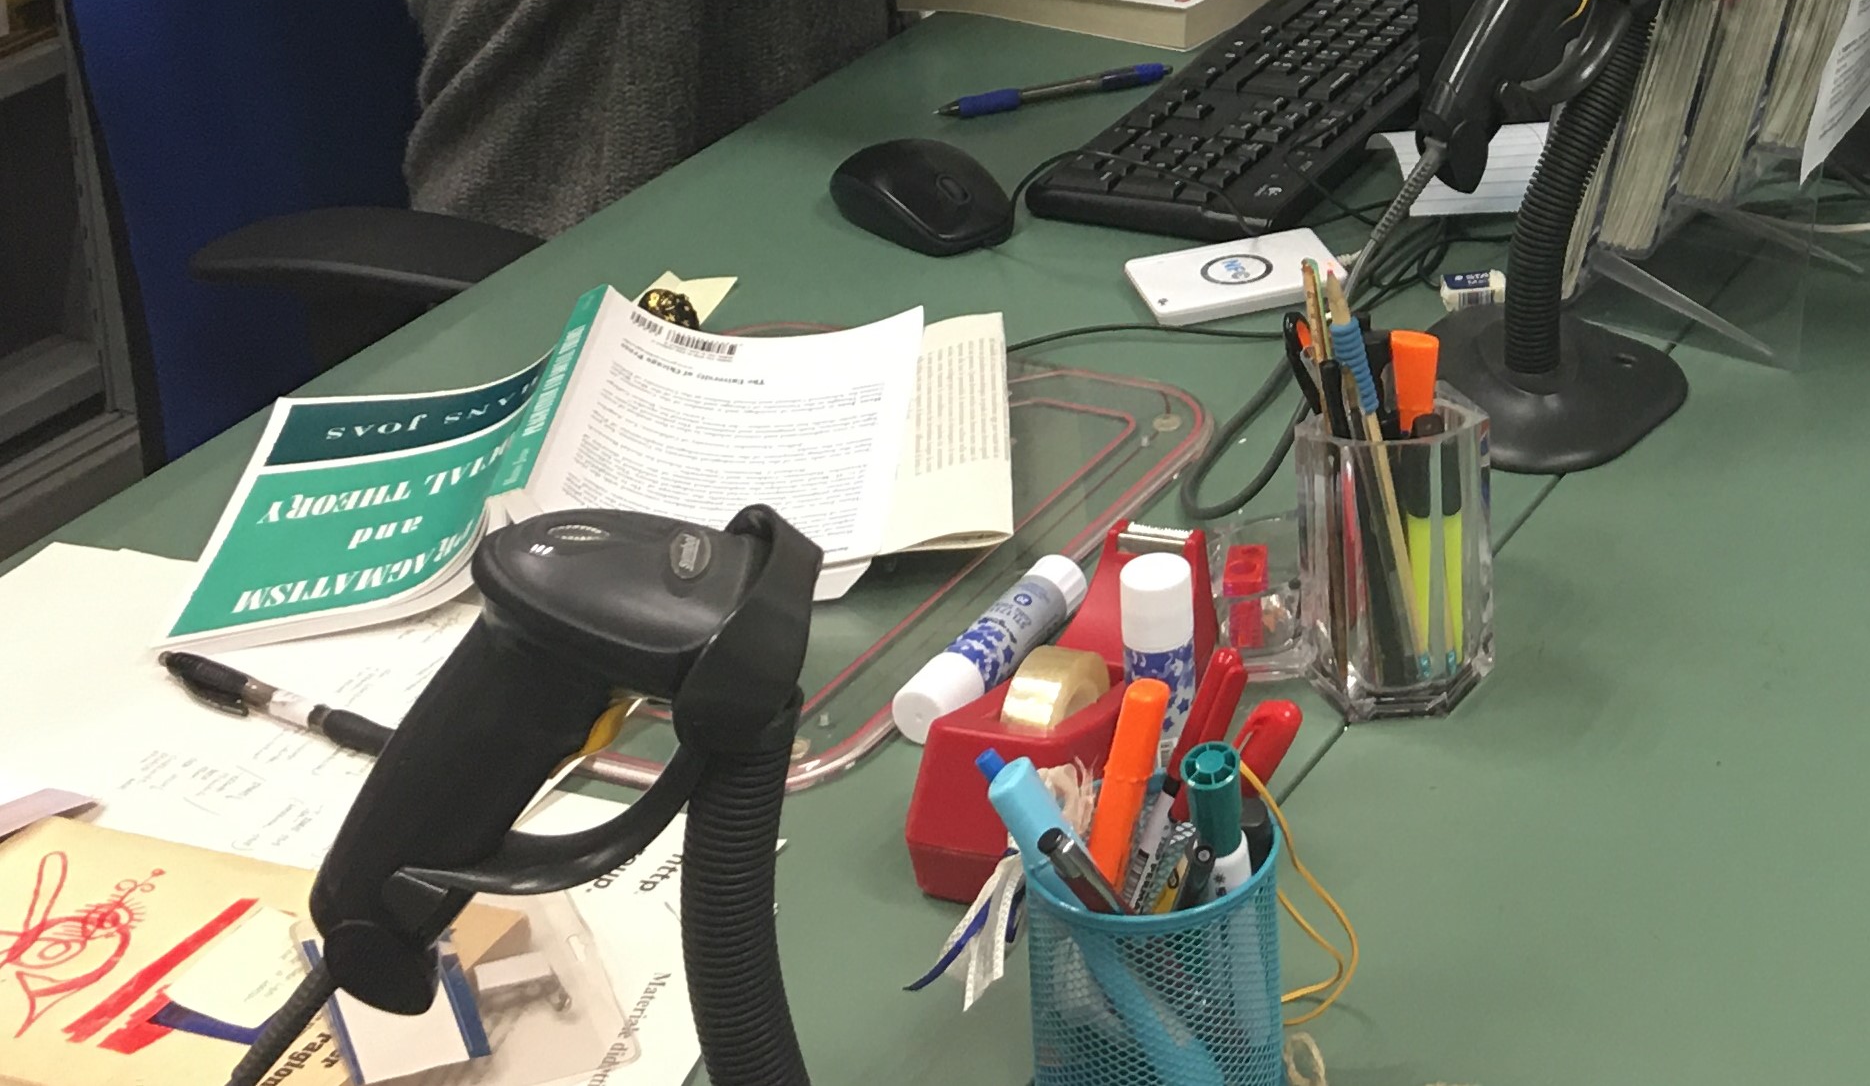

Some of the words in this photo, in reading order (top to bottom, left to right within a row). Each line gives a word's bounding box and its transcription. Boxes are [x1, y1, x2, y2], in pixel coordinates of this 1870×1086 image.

[326, 414, 427, 441] JOAS
[257, 481, 411, 526] THEORY
[348, 515, 423, 550] and
[232, 518, 475, 614] PRAGMATISM
